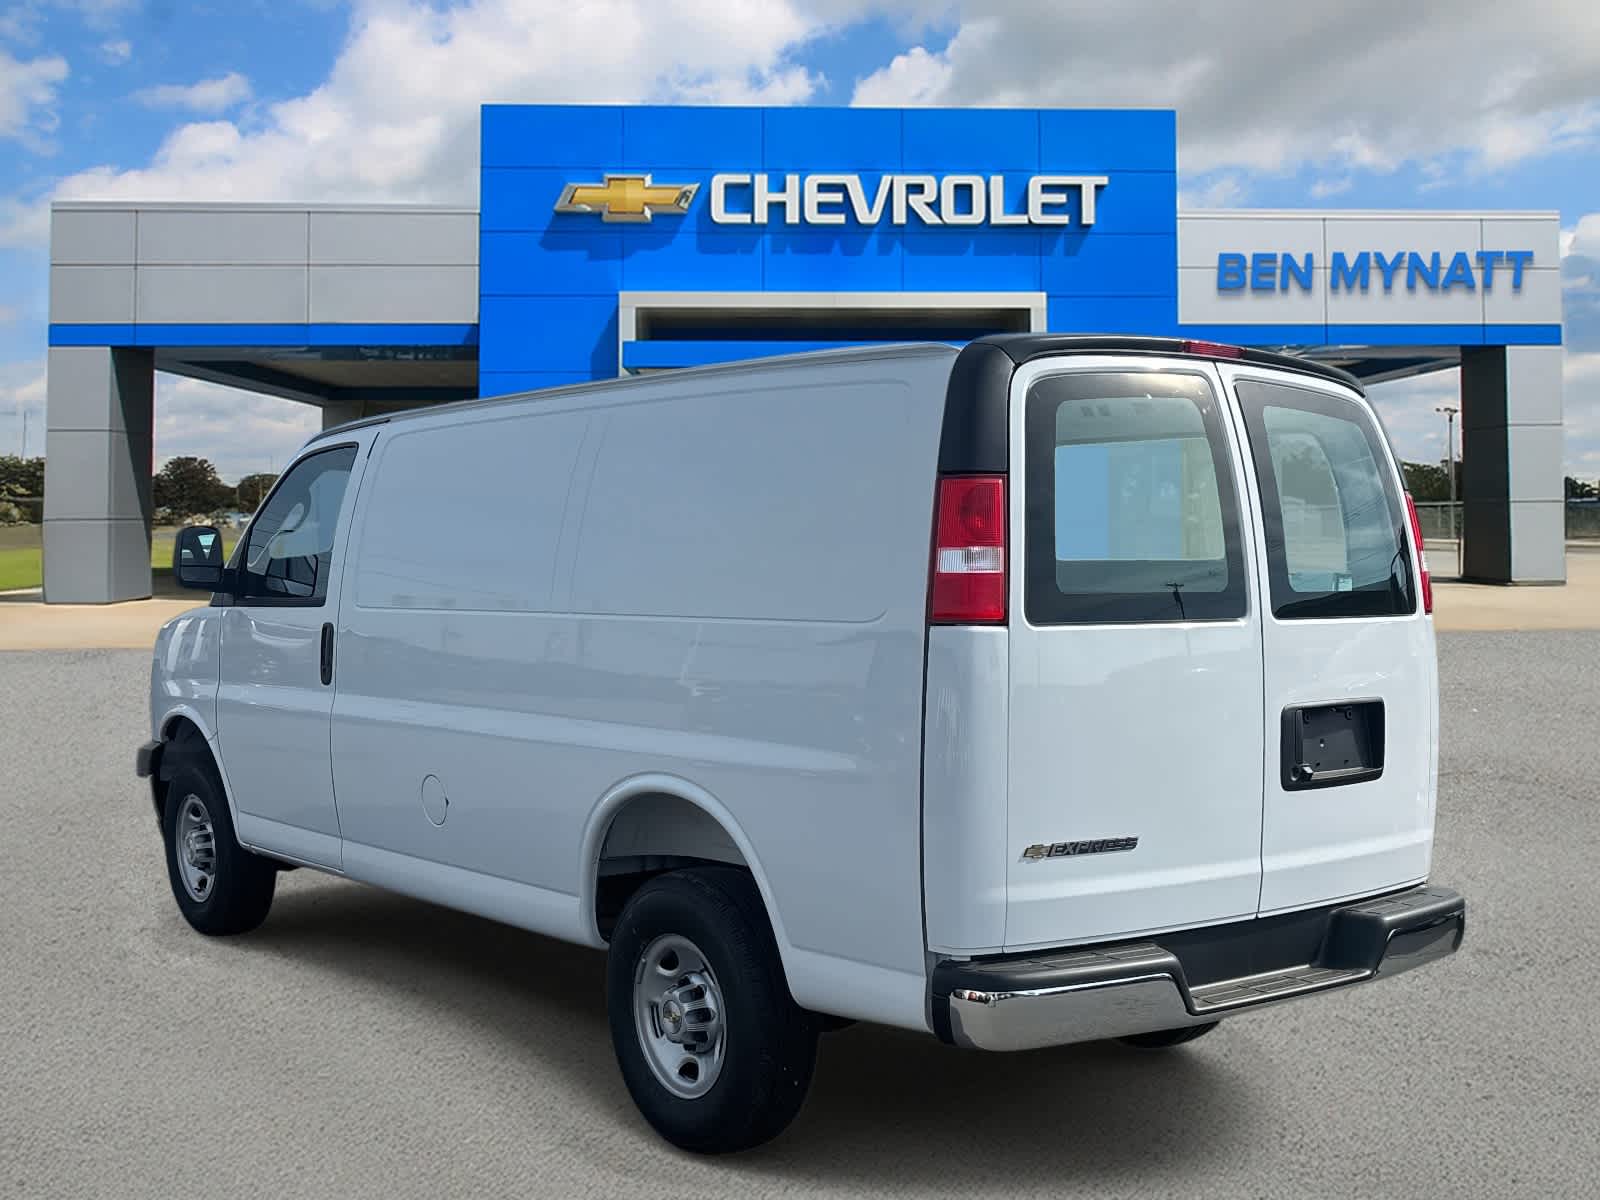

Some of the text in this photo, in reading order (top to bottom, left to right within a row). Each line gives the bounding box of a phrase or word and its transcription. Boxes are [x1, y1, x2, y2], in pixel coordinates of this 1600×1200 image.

[710, 173, 1109, 226] CHEVROLET
[1217, 250, 1534, 291] BEN MYNATT
[1047, 836, 1138, 857] EXPRESS
